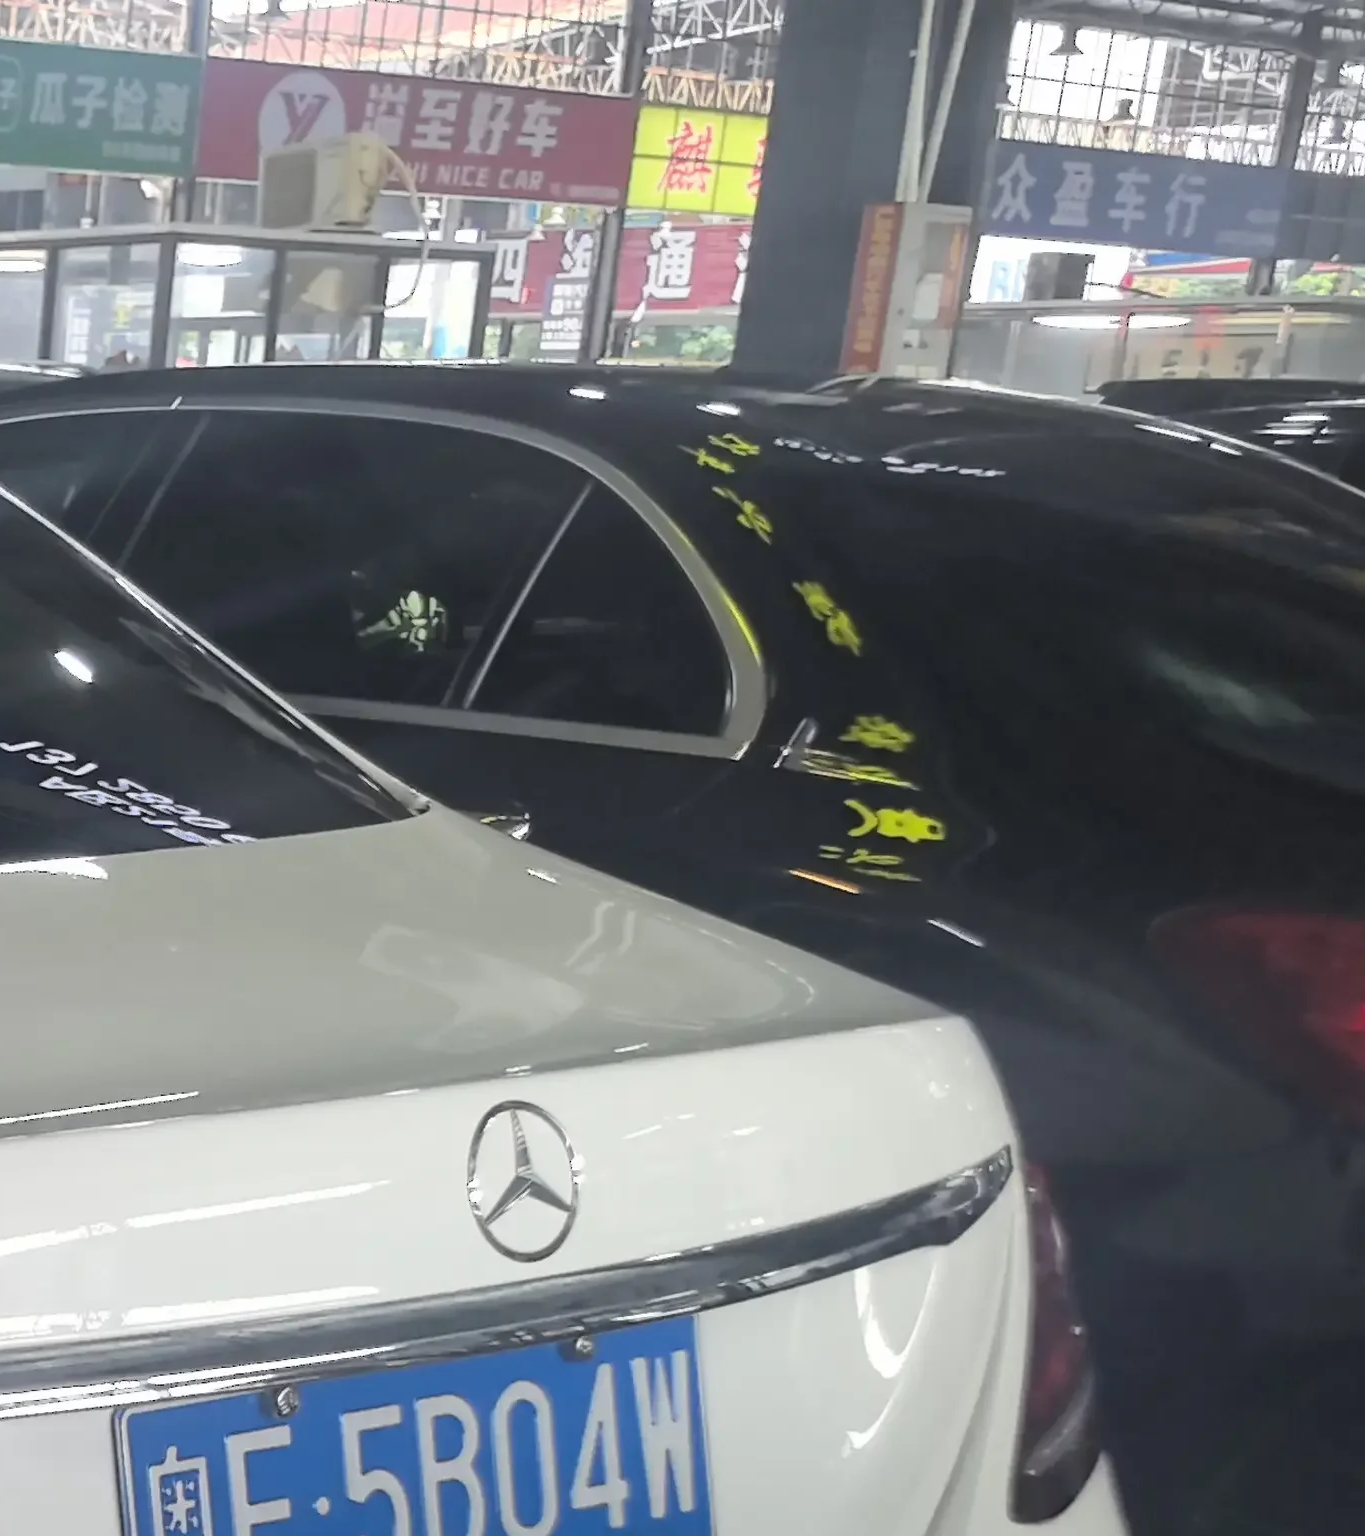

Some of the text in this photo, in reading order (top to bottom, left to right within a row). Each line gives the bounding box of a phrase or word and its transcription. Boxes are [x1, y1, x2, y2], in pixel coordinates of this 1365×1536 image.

[29, 72, 190, 136] 瓜子检测
[435, 163, 490, 188] NICE
[497, 168, 545, 191] CAR
[991, 153, 1210, 239] 众盈车行
